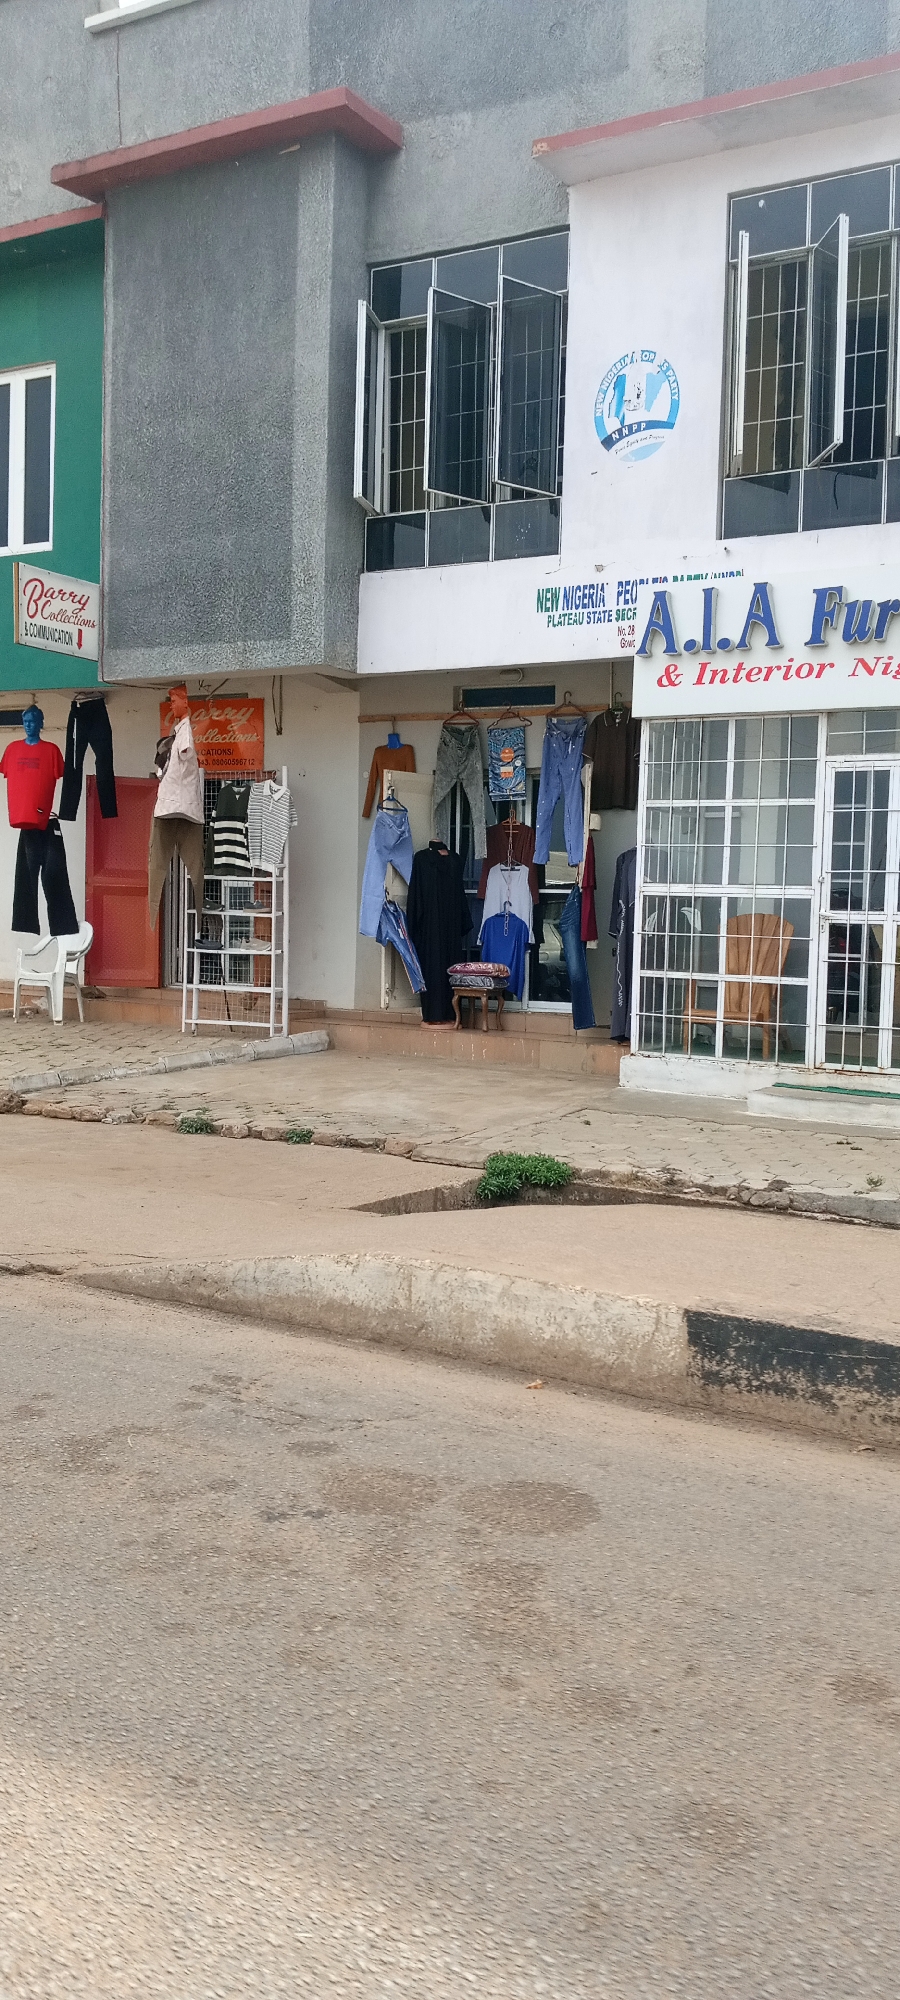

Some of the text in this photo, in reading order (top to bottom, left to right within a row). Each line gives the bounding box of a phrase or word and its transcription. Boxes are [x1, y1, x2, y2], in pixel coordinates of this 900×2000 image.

[666, 370, 679, 401] PARTY
[611, 422, 646, 441] NNPP
[23, 578, 90, 619] Barry
[536, 586, 561, 613] NEW
[562, 583, 606, 611] NIGERIA
[41, 600, 97, 629] Collections
[547, 611, 585, 628] PLATEAU
[586, 609, 613, 625] STATE
[635, 582, 900, 656] A.I.A Fur
[24, 621, 73, 646] & COMMUNICATION
[656, 663, 684, 688] &
[692, 657, 835, 686] Interior
[193, 724, 260, 744] ollections
